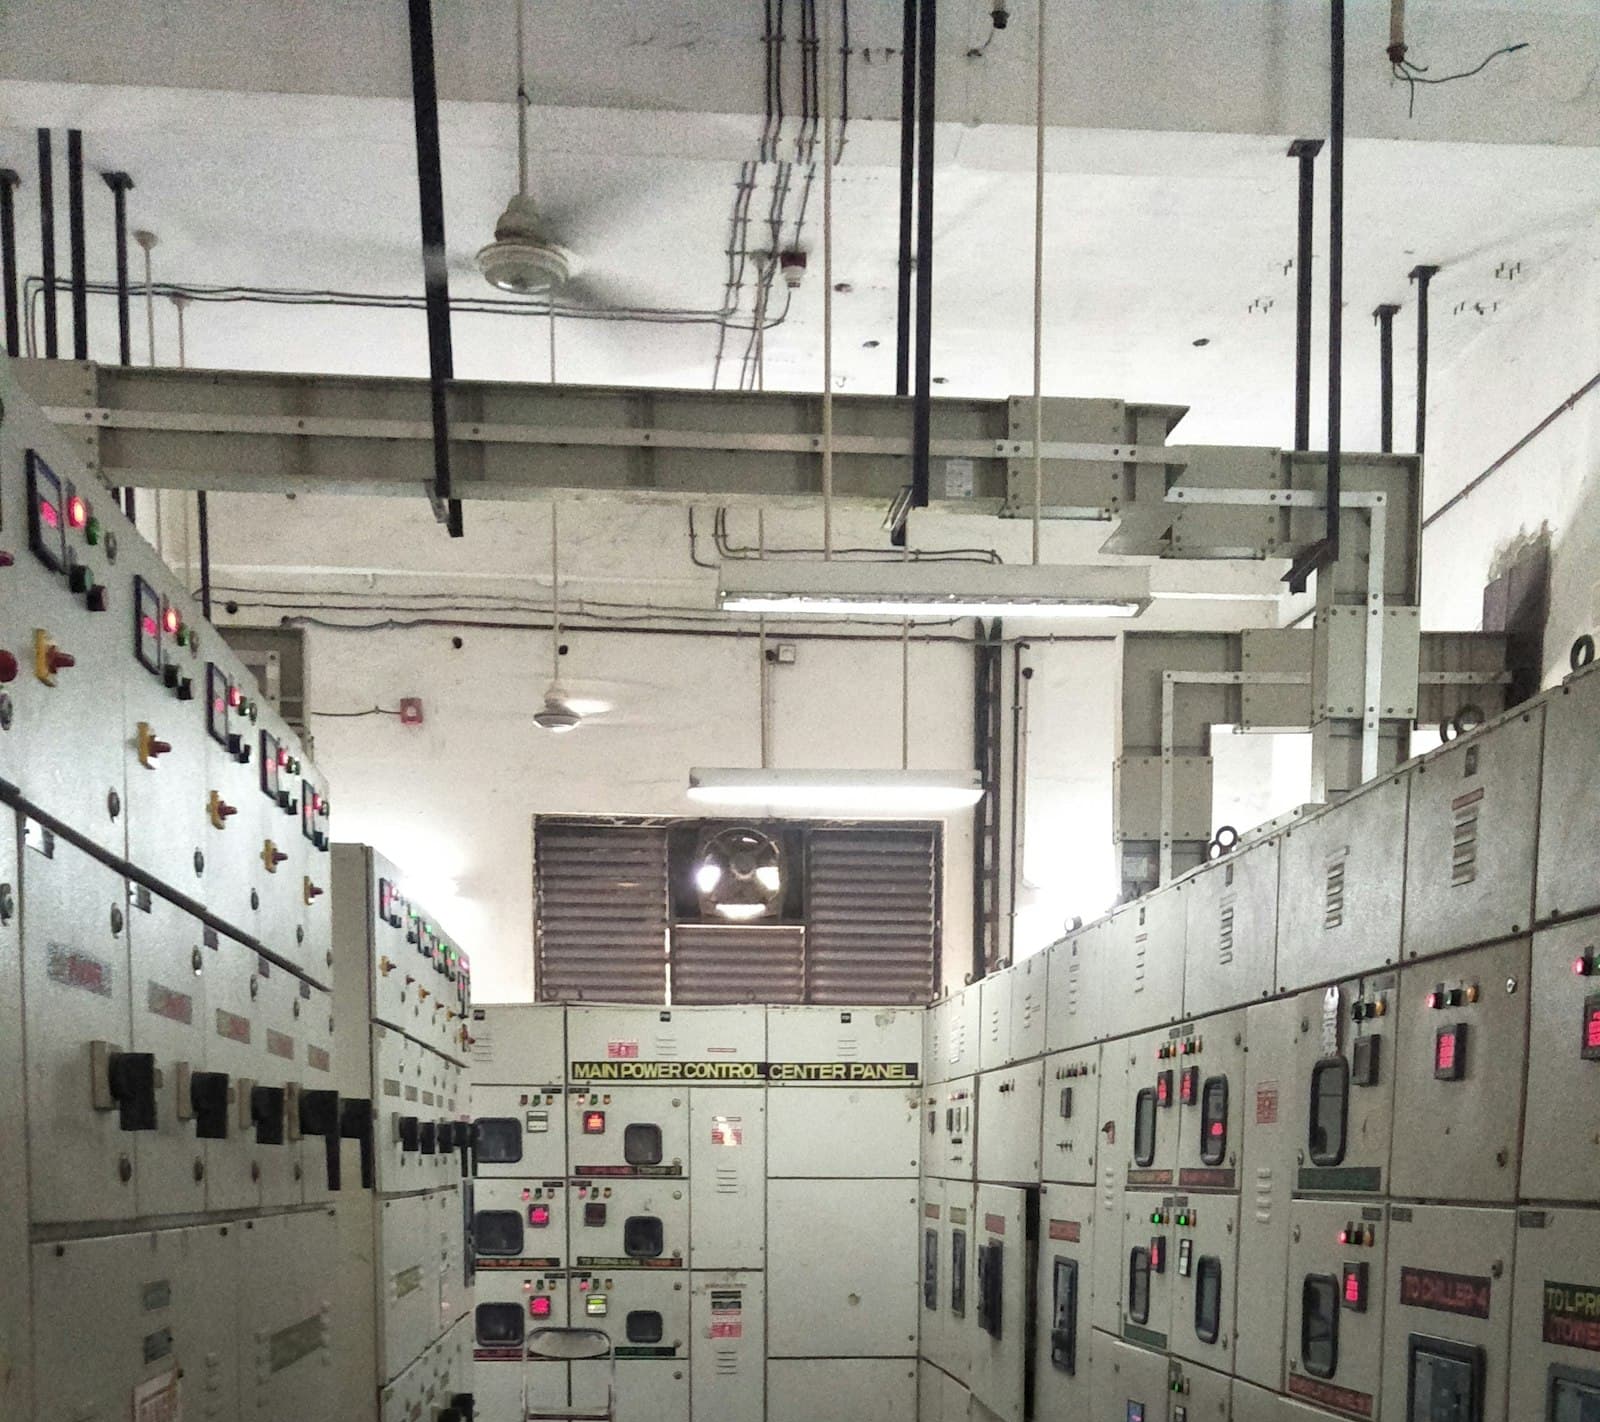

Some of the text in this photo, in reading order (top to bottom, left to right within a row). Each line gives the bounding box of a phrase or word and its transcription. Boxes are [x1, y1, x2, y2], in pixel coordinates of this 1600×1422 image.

[573, 1063, 915, 1080] MAIN POWER CONTROL CENTER PANEL
